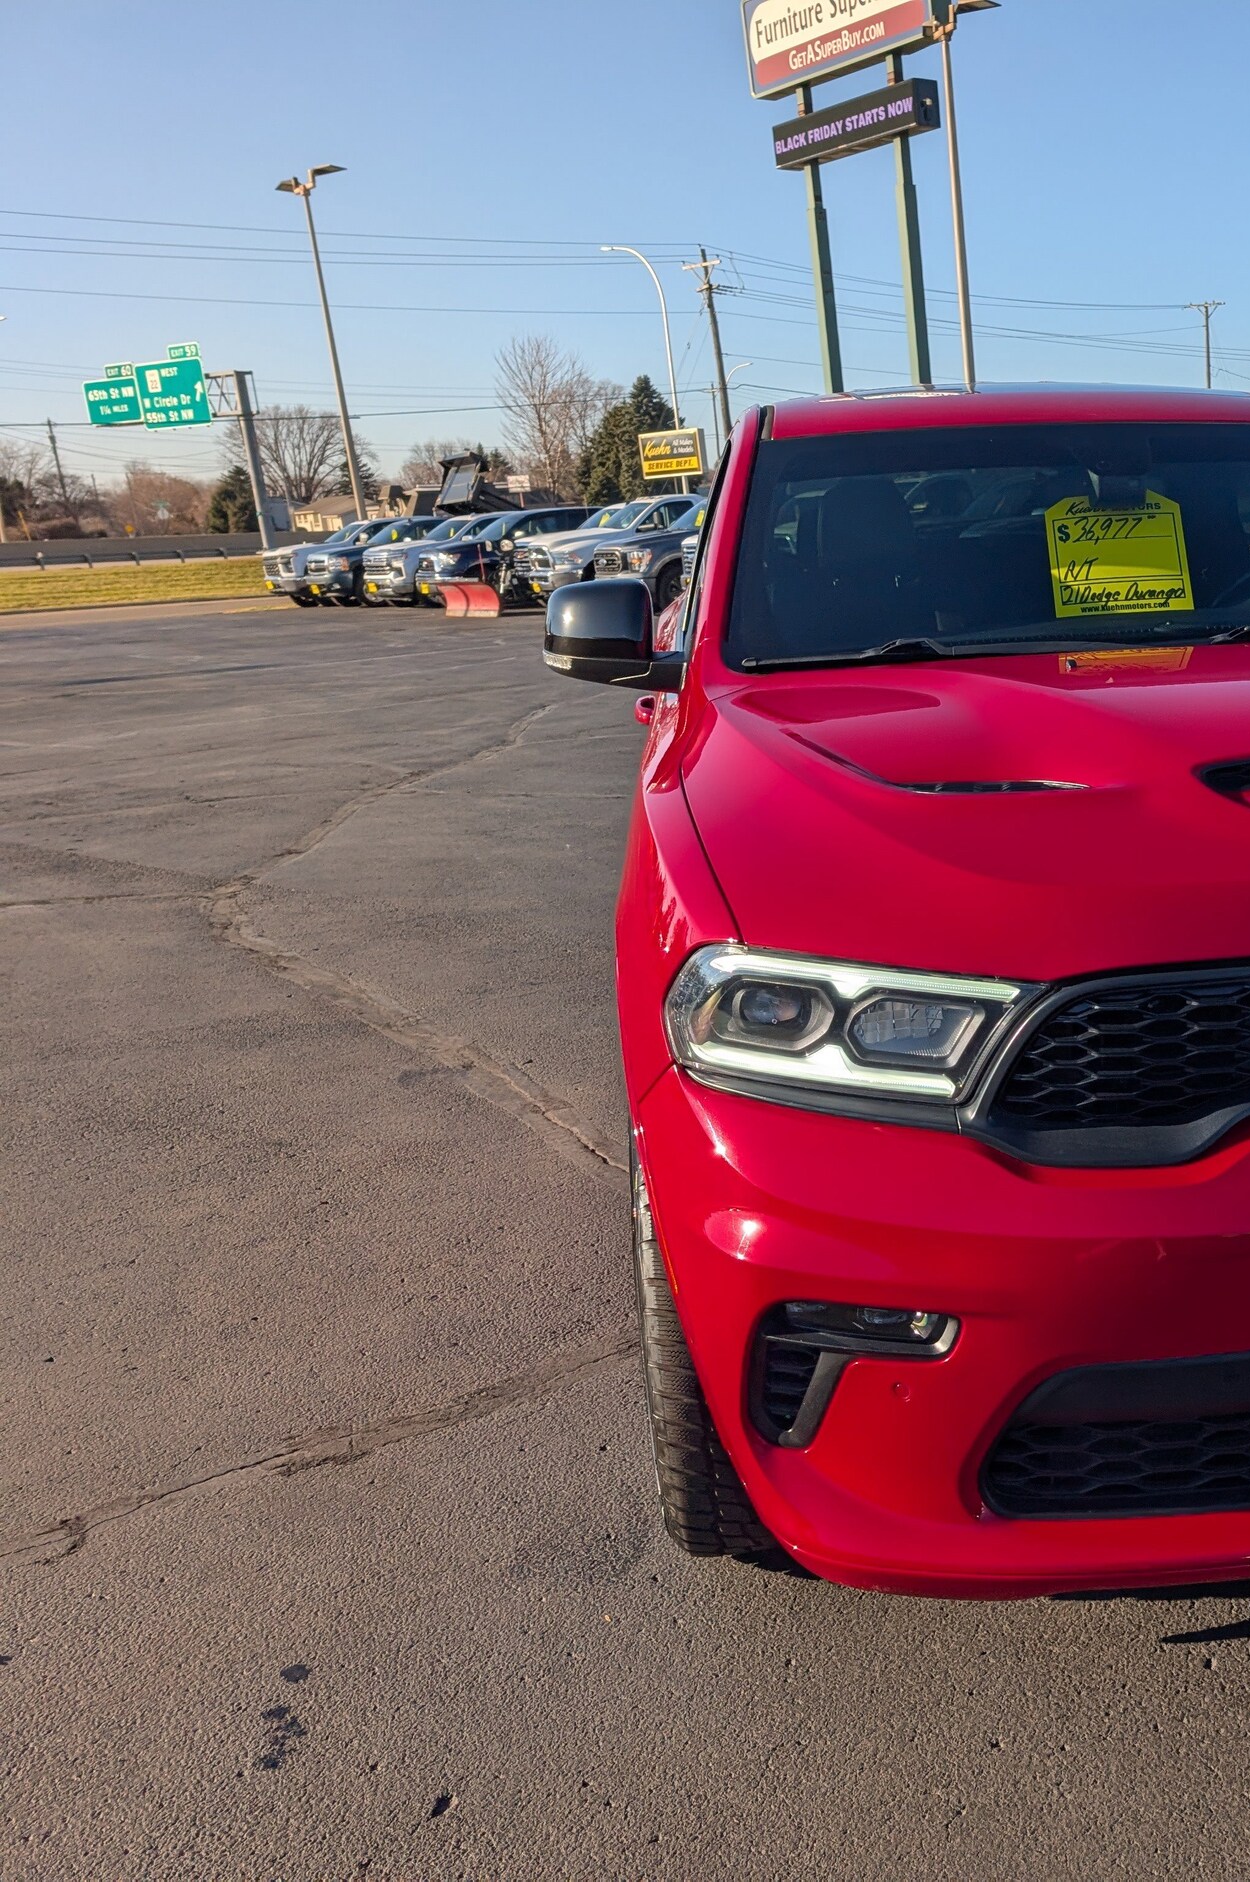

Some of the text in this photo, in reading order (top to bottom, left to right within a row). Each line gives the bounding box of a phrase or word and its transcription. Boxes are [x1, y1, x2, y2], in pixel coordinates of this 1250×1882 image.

[755, 7, 824, 49] Furniture
[775, 96, 913, 154] BLACK FRIDAY STARTS NOW
[170, 345, 197, 357] EXIT 59
[107, 365, 132, 377] EXIT 60
[160, 367, 178, 377] WEST
[149, 379, 159, 390] 22
[88, 386, 135, 401] 65th St NW
[153, 395, 179, 408] Circle
[180, 393, 191, 405] Dr
[112, 404, 128, 412] MILES
[146, 409, 194, 423] 55th St NW
[644, 438, 671, 458] Kuehn
[679, 437, 694, 446] Makes
[647, 459, 694, 471] SERVICE DEPT.
[1064, 556, 1099, 581] R/T
[1080, 585, 1121, 607] Dodge
[1124, 581, 1184, 605] Durango
